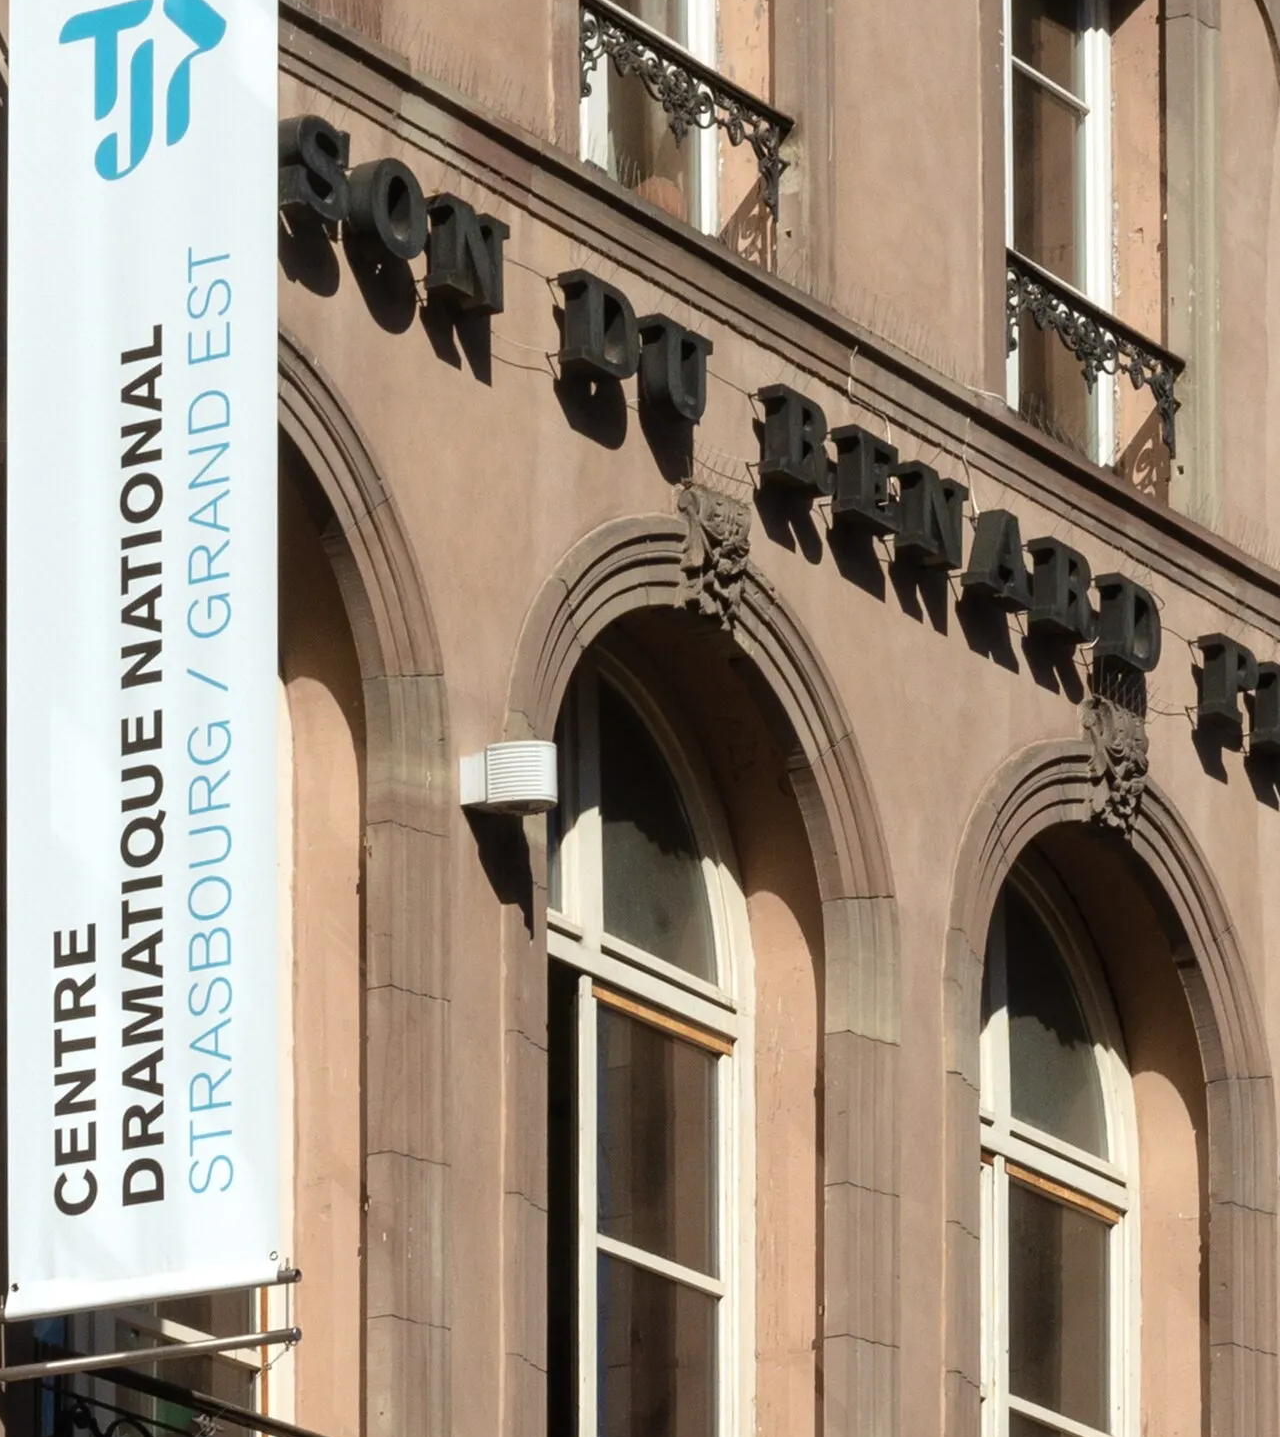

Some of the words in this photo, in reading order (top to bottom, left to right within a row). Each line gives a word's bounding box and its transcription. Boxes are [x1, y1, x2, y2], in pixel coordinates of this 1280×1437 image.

[186, 246, 232, 365] EST
[557, 268, 713, 420] DU
[757, 383, 1161, 672] RENARD
[120, 323, 164, 691] NATIONAL
[186, 389, 231, 639] GRAND
[53, 922, 98, 1217] CENTRE
[120, 708, 167, 1207] DRAMATIQUE
[186, 719, 234, 1193] STRASBOURG
